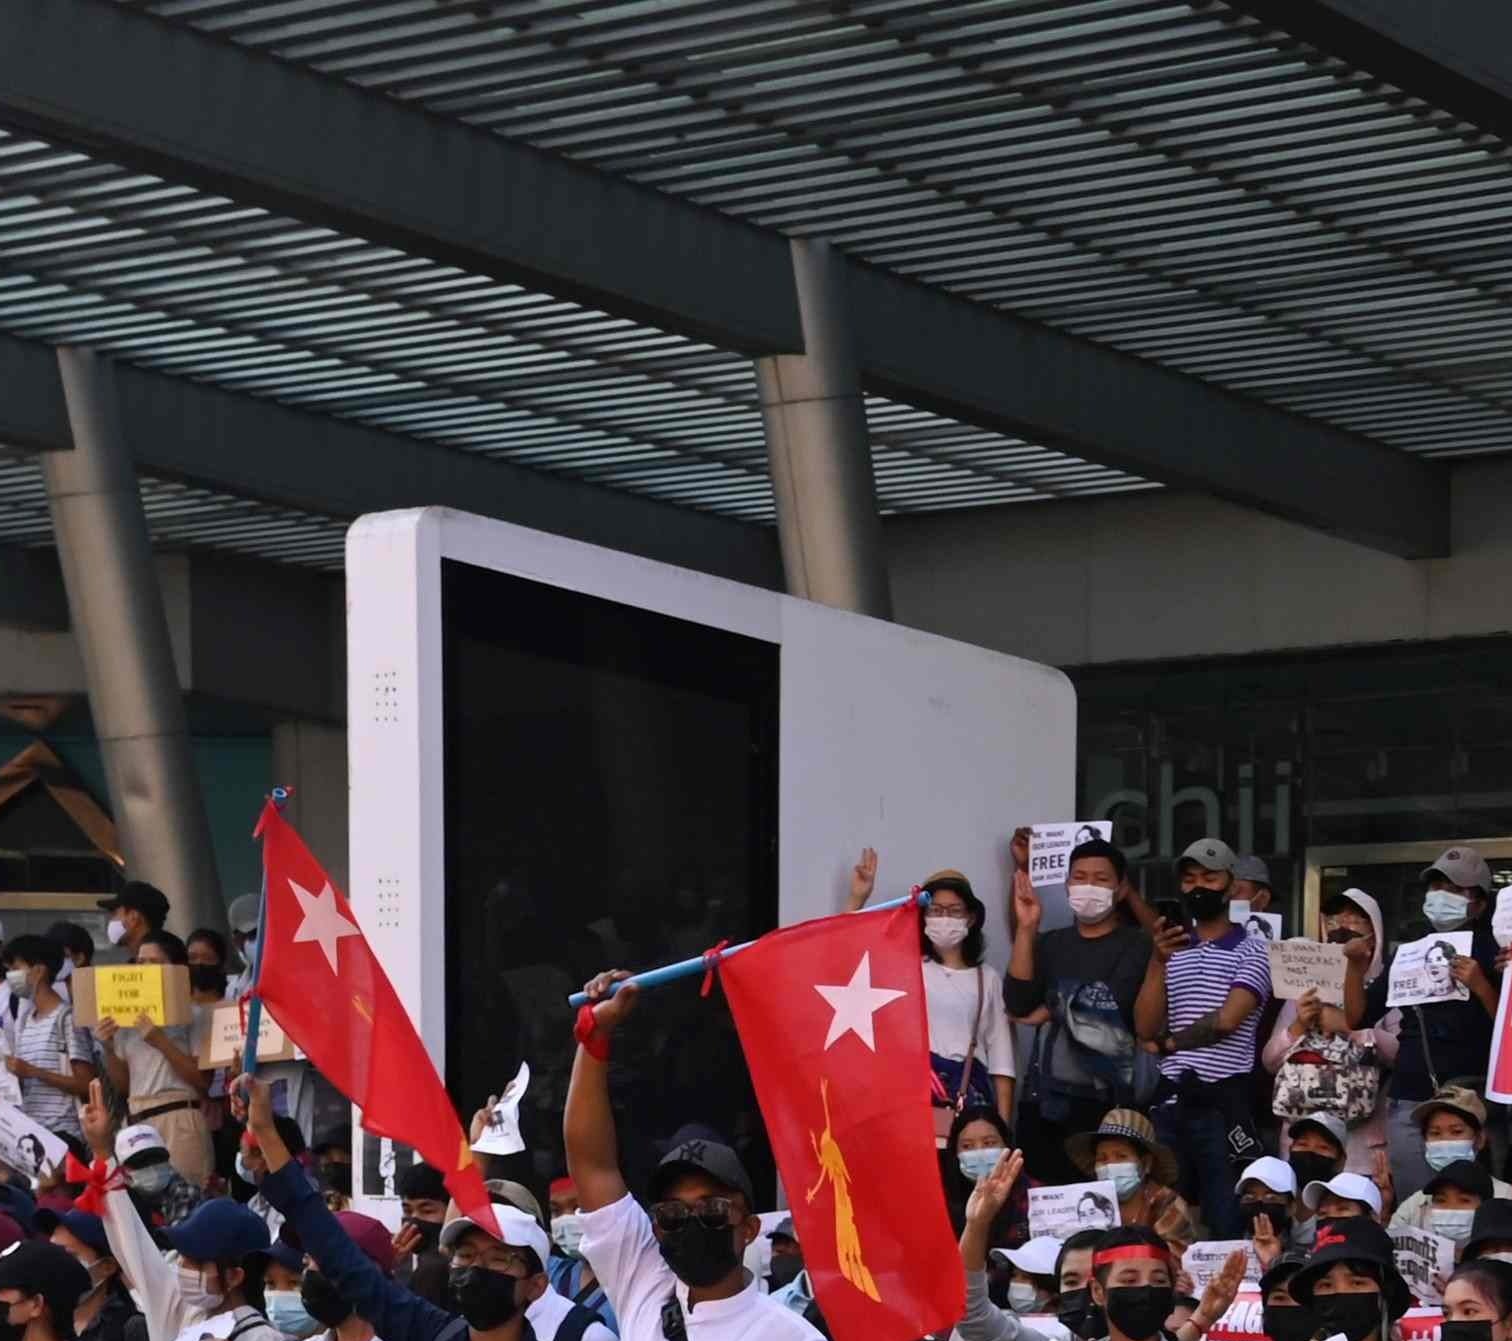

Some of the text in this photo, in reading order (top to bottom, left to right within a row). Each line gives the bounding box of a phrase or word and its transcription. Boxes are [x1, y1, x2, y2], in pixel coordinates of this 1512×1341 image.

[1032, 854, 1065, 871] FREE
[1393, 977, 1418, 992] FREE
[1047, 1206, 1076, 1216] LEADER
